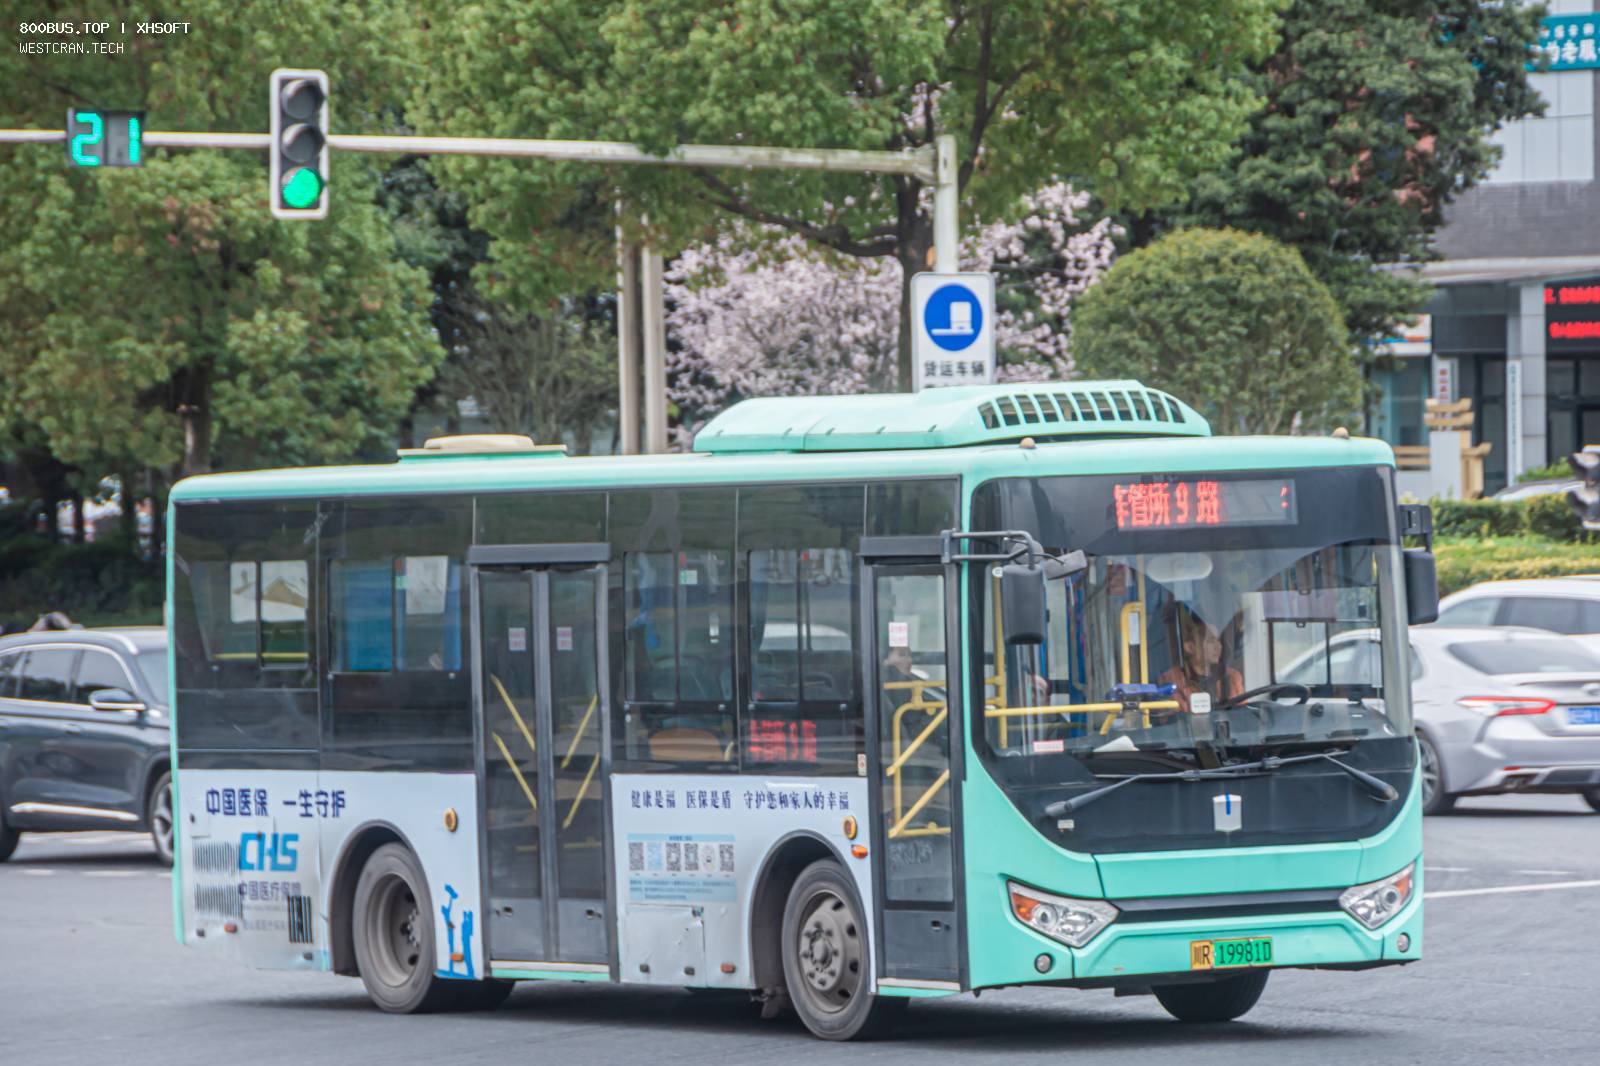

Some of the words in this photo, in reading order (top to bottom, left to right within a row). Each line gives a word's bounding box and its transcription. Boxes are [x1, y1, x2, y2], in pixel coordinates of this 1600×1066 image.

[72, 112, 140, 166] 21
[924, 360, 984, 377] 货运车辆
[206, 787, 268, 816] 中国医保
[282, 789, 346, 818] 一生守护
[631, 789, 676, 809] 健康是福
[685, 789, 732, 809] 医保是盾
[743, 790, 849, 810] 守护您和家人的幸福
[239, 832, 299, 872] CHS
